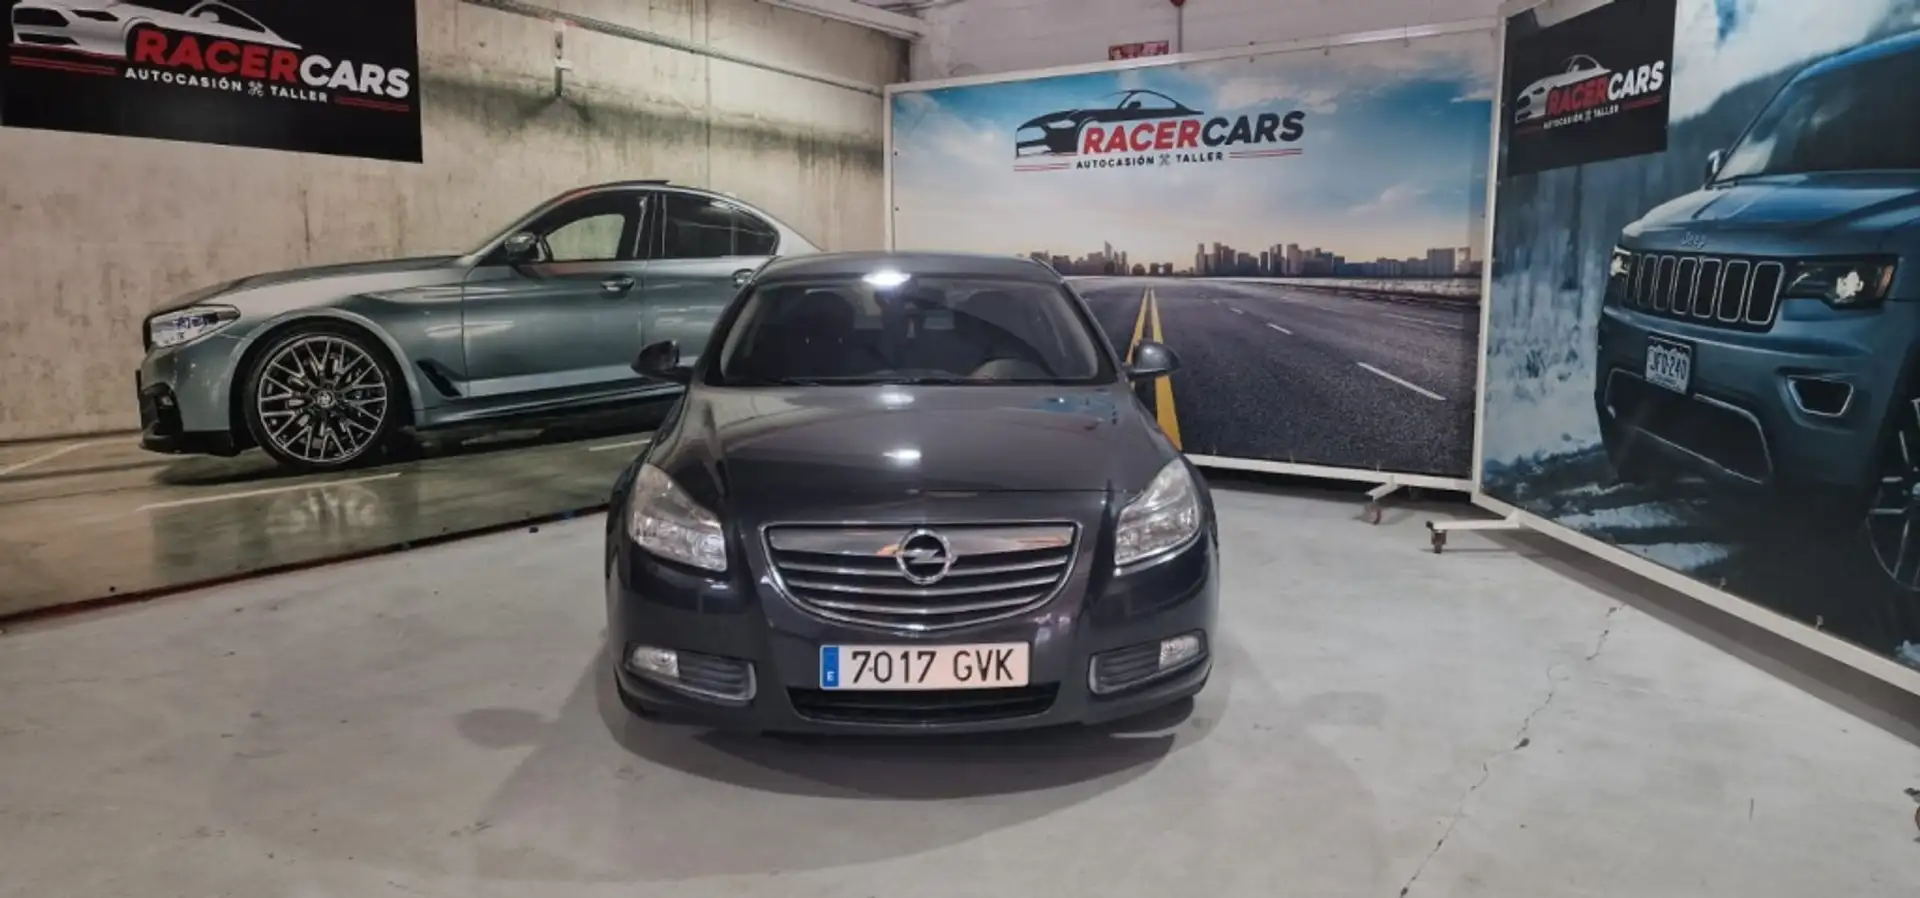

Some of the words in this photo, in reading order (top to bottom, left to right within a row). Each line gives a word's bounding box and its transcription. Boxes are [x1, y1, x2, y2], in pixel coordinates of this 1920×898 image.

[135, 29, 410, 98] RACERCARS
[125, 67, 242, 91] AUTOCASIÓN
[270, 85, 328, 103] TALLER
[1083, 110, 1306, 154] RACERCARS
[1076, 153, 1155, 169] AUTOCASIÓN
[1175, 150, 1224, 163] TALLER
[826, 671, 835, 682] E
[953, 648, 1014, 682] GVK
